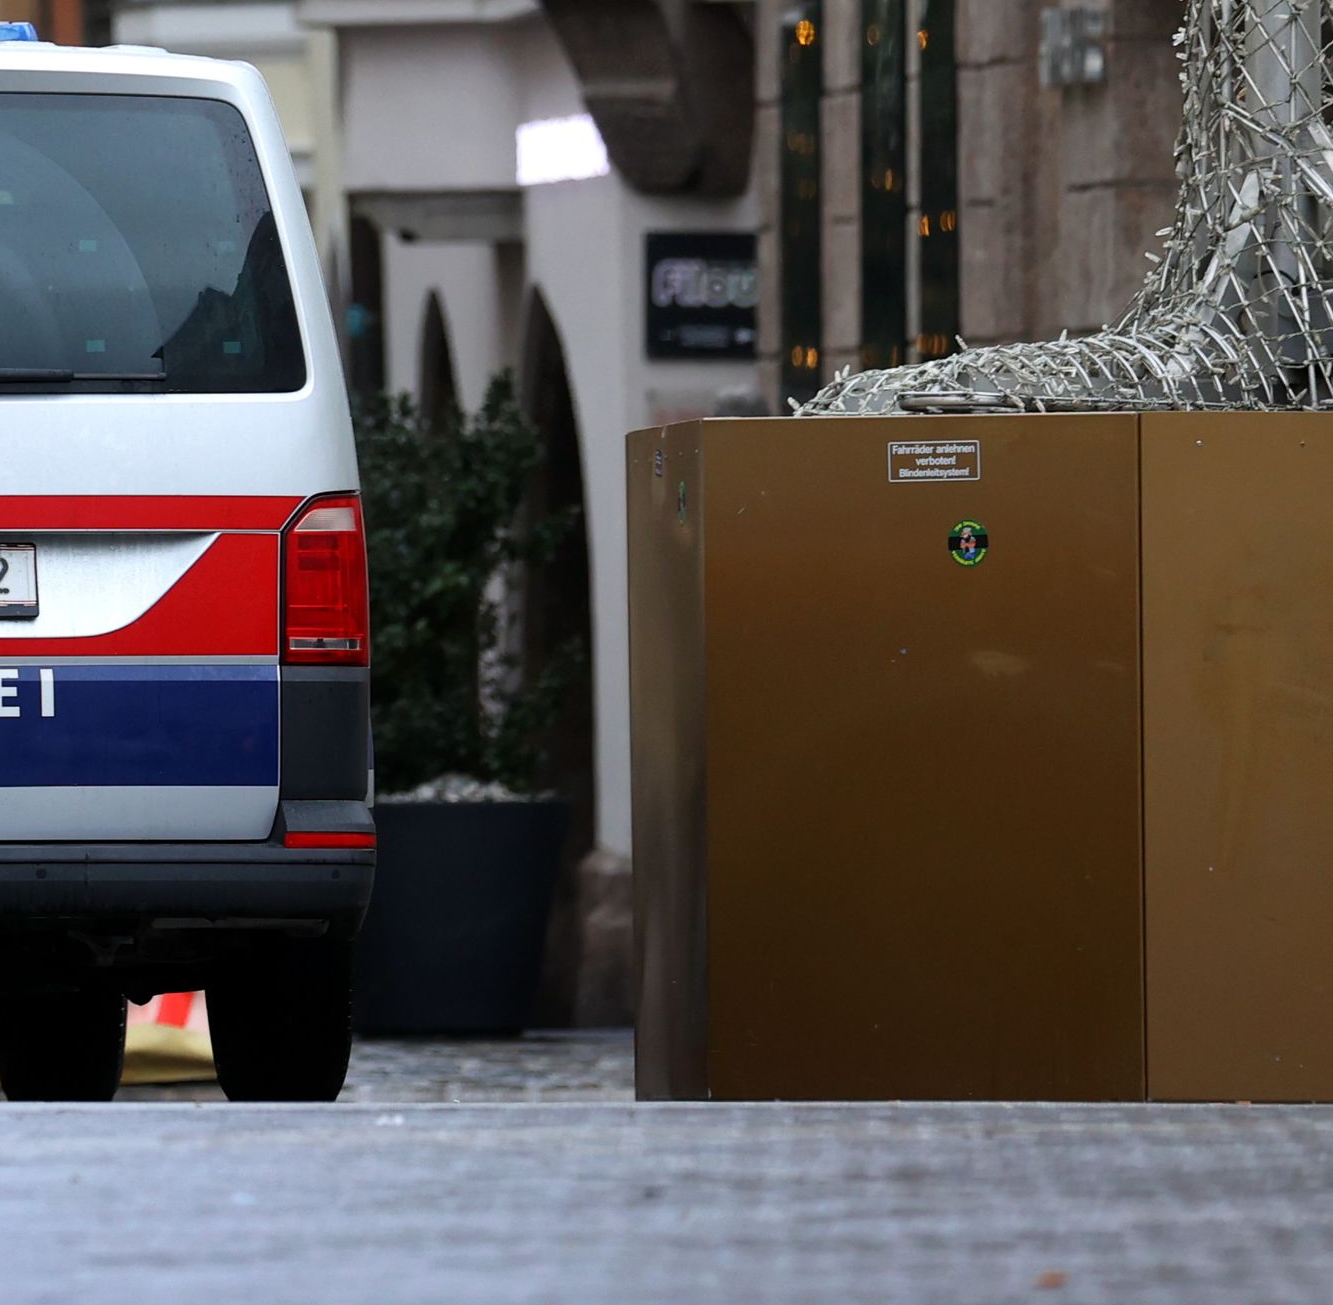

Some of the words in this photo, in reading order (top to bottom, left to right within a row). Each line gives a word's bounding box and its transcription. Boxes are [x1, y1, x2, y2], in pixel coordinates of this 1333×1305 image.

[892, 445, 934, 455] Fahrräder
[935, 444, 975, 454] anlehnen
[915, 456, 956, 466] verboten!
[899, 467, 970, 478] Blindenleitsystem!
